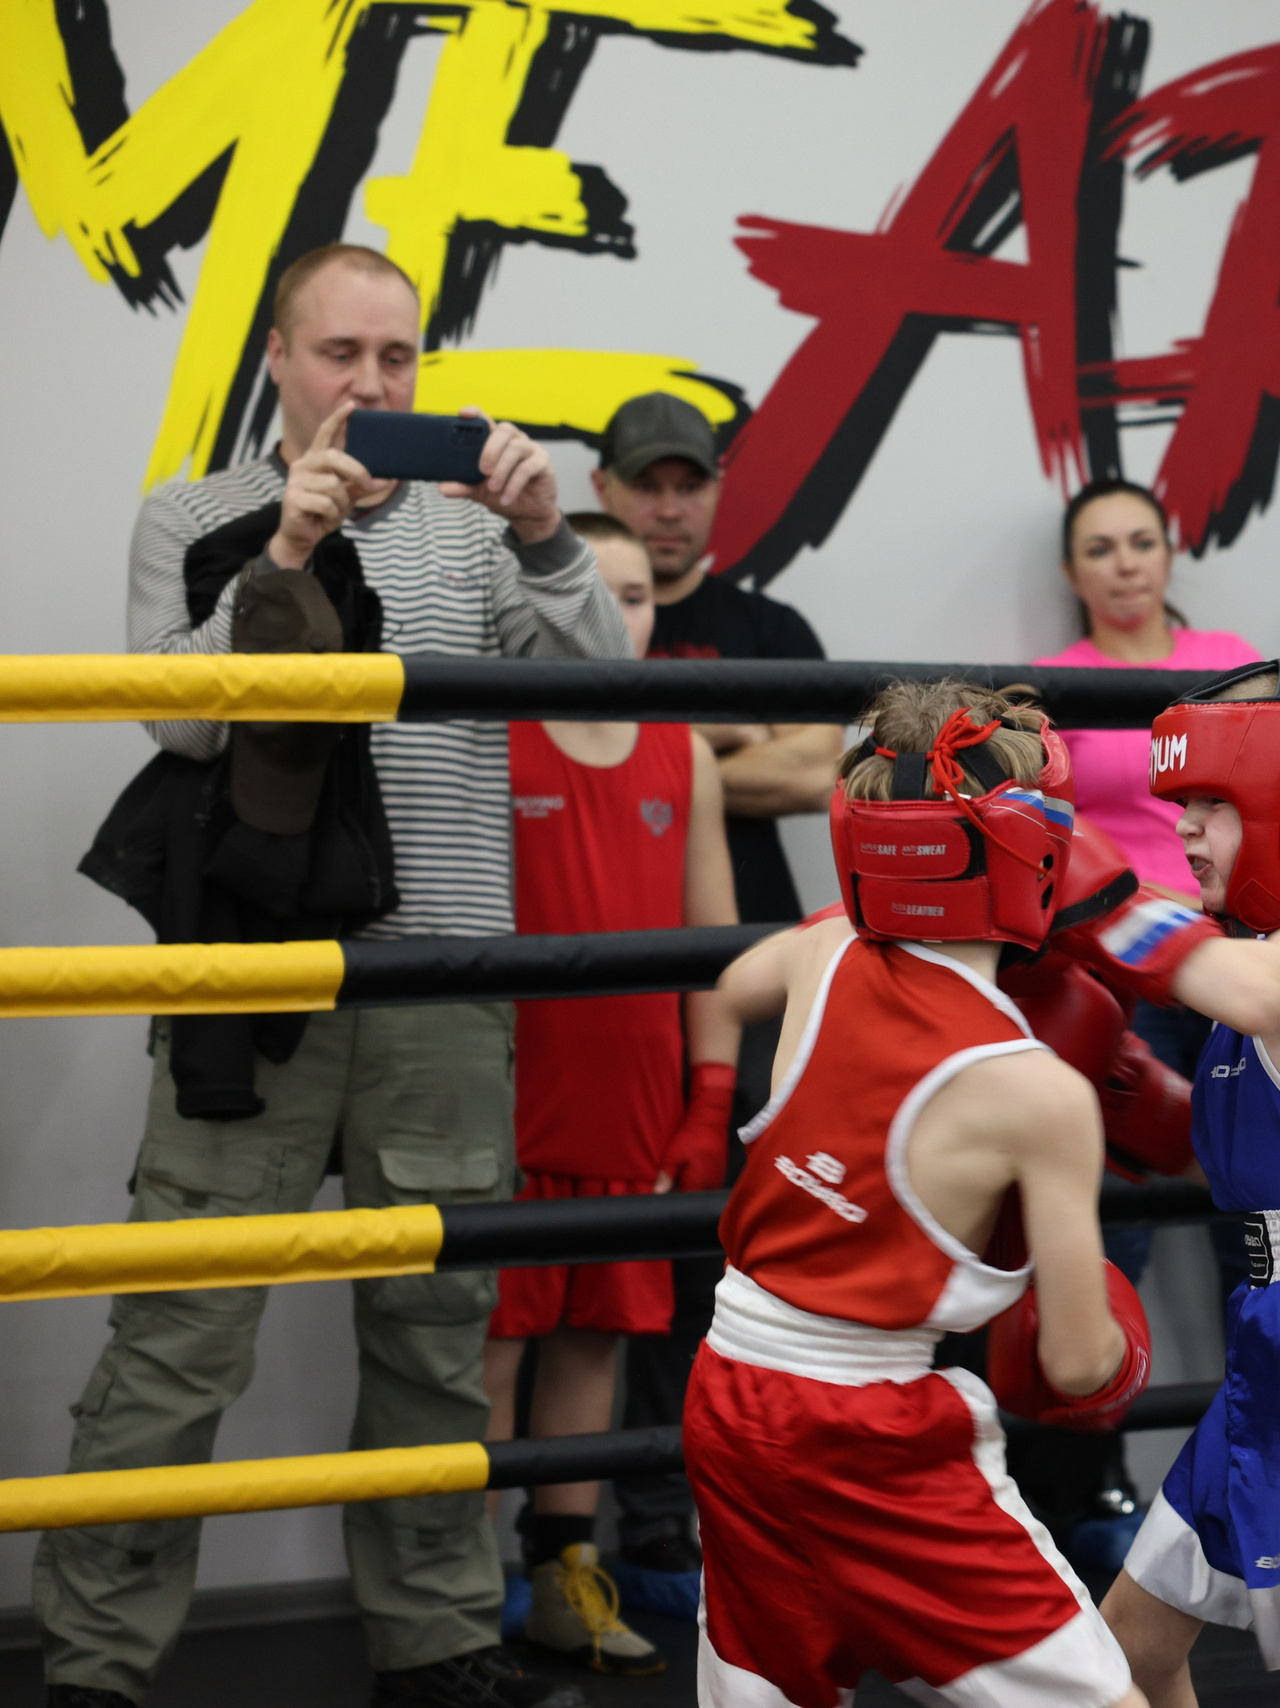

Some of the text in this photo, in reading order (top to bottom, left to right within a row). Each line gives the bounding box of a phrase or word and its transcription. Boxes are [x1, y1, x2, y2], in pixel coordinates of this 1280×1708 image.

[1149, 732, 1188, 787] NUM
[877, 844, 899, 856] SAFE
[916, 844, 947, 856] SWEAT
